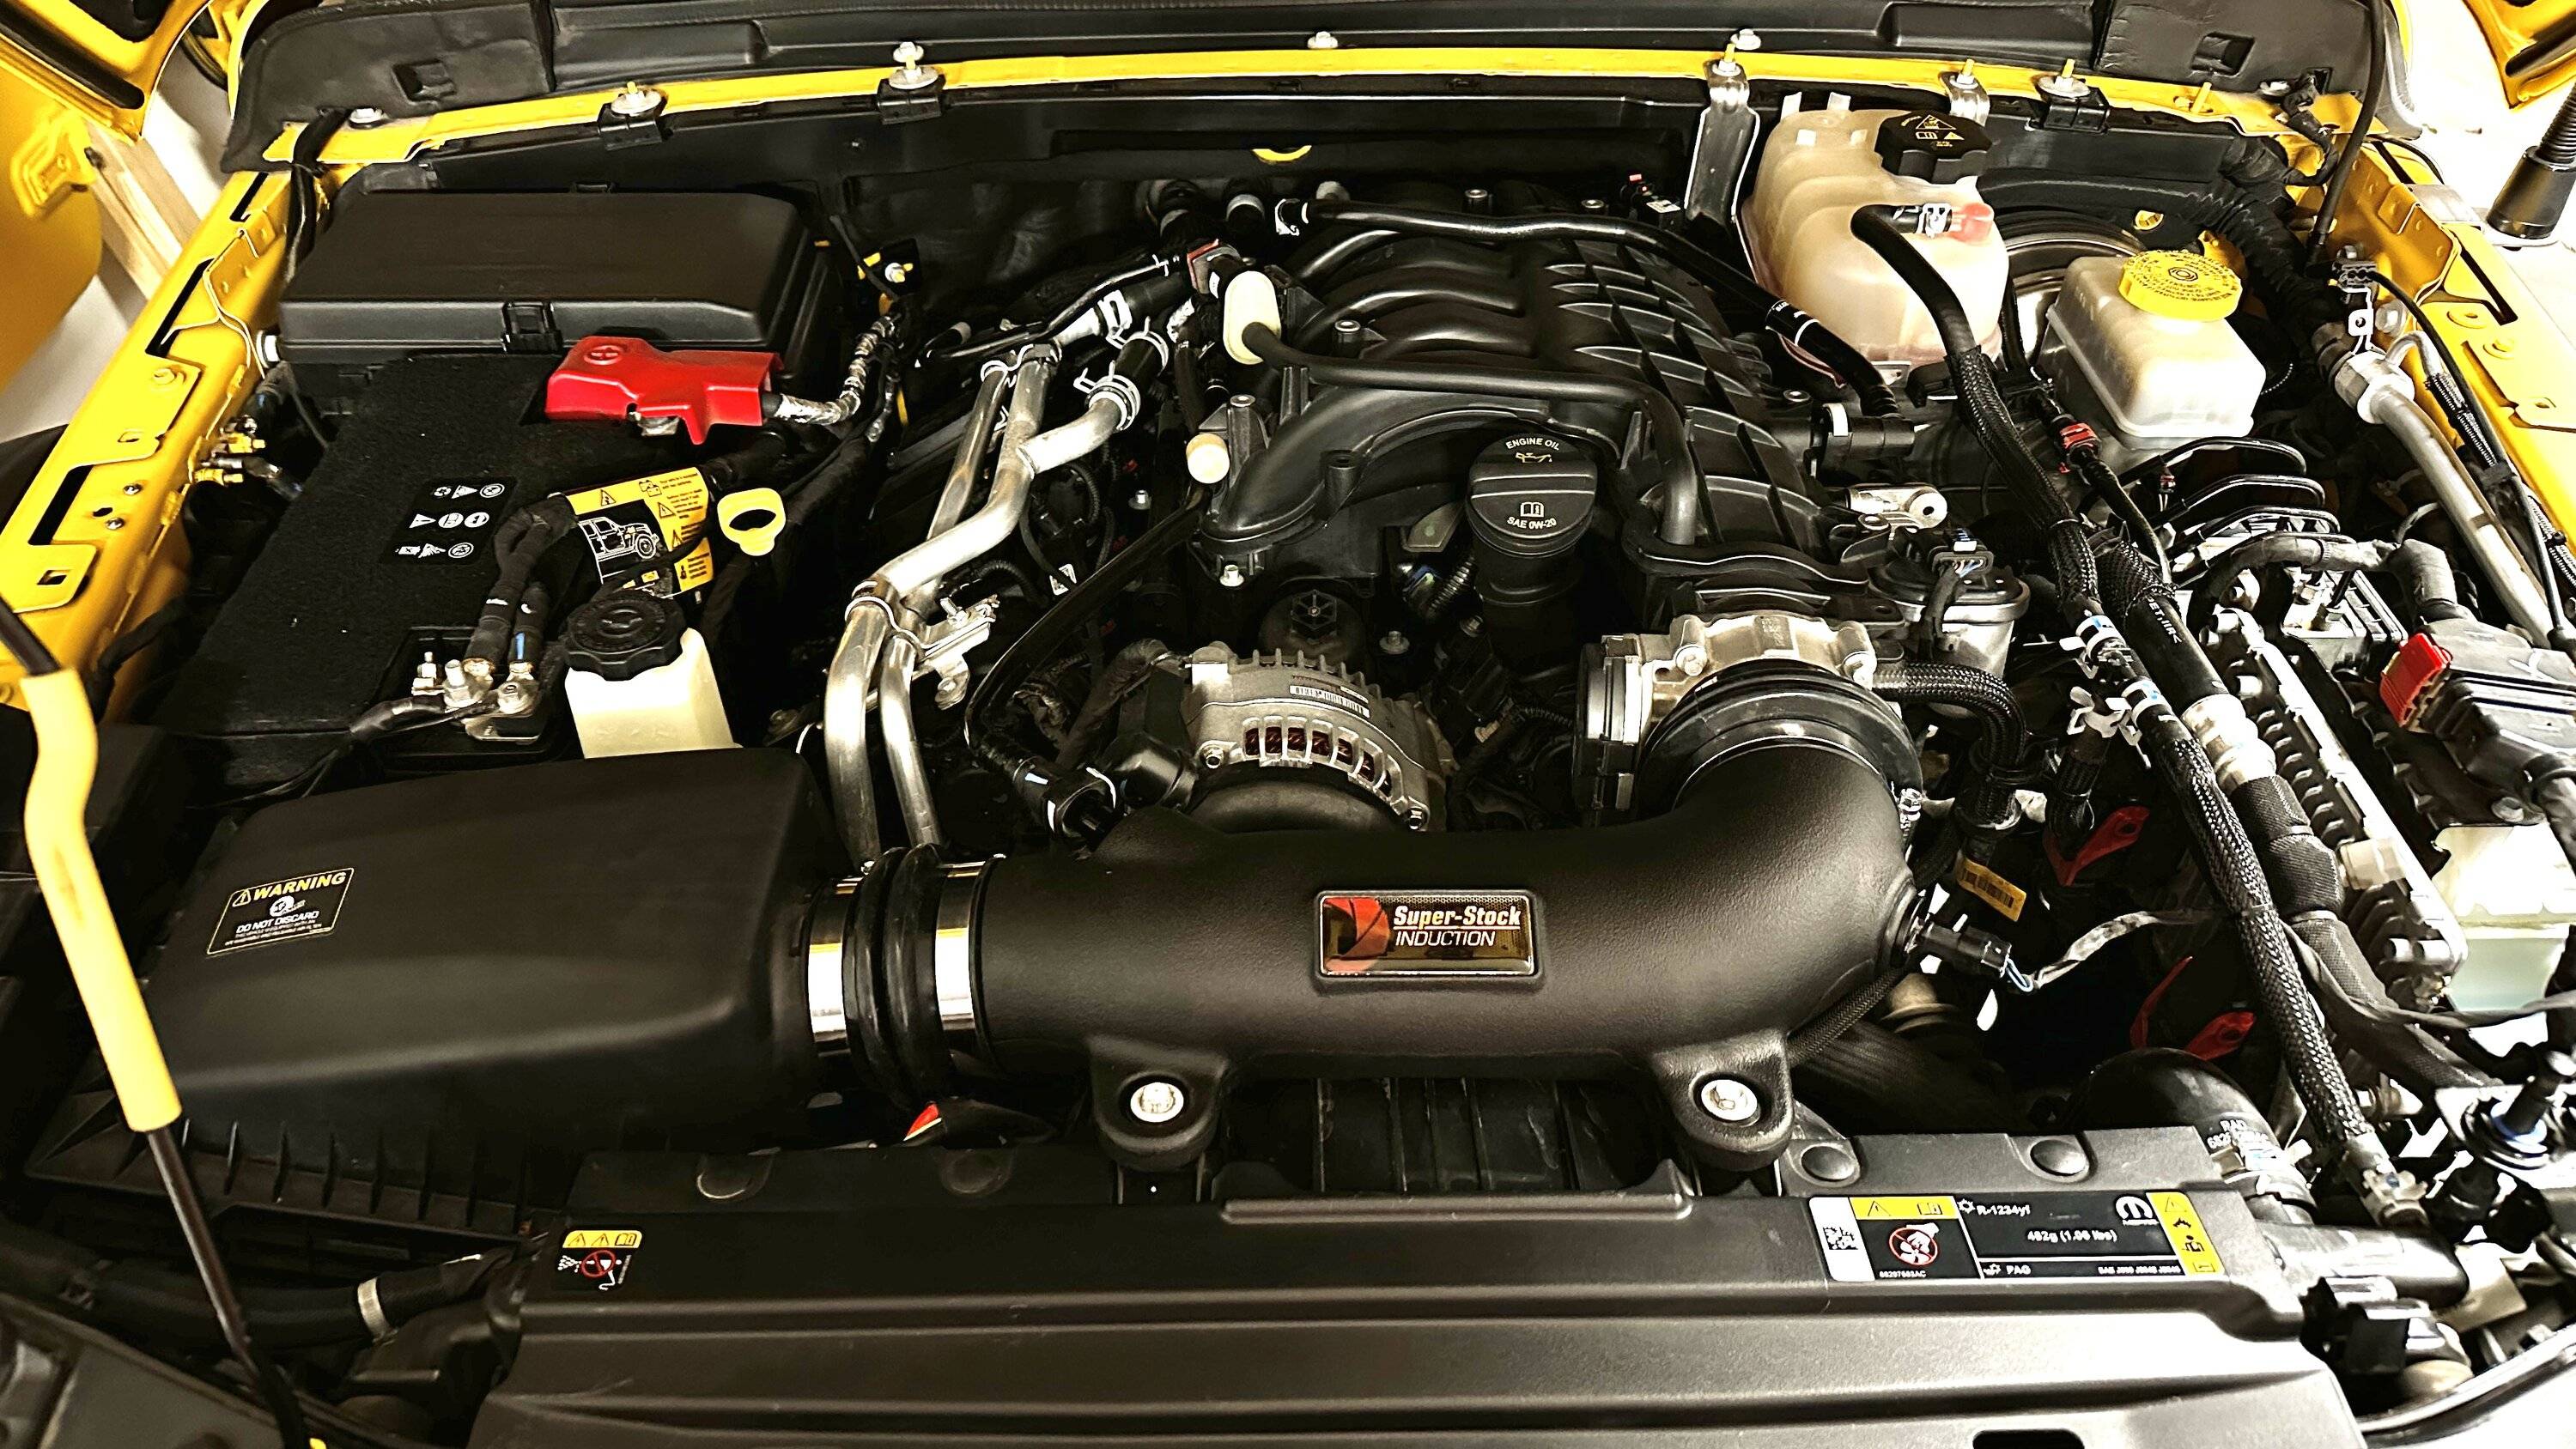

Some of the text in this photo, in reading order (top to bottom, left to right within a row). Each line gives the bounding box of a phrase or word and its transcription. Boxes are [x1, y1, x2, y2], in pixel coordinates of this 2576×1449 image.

[1505, 438, 1559, 451] ENGINE OIL
[1507, 517, 1557, 530] SAE 0W-20
[252, 871, 346, 900] WARNING
[235, 923, 251, 934] DO
[252, 918, 272, 931] NOT
[274, 910, 320, 926] DISCARD
[1394, 905, 1521, 929] Super-Stock
[1395, 931, 1496, 947] INDUCTION
[2007, 1264, 2032, 1275] PAG
